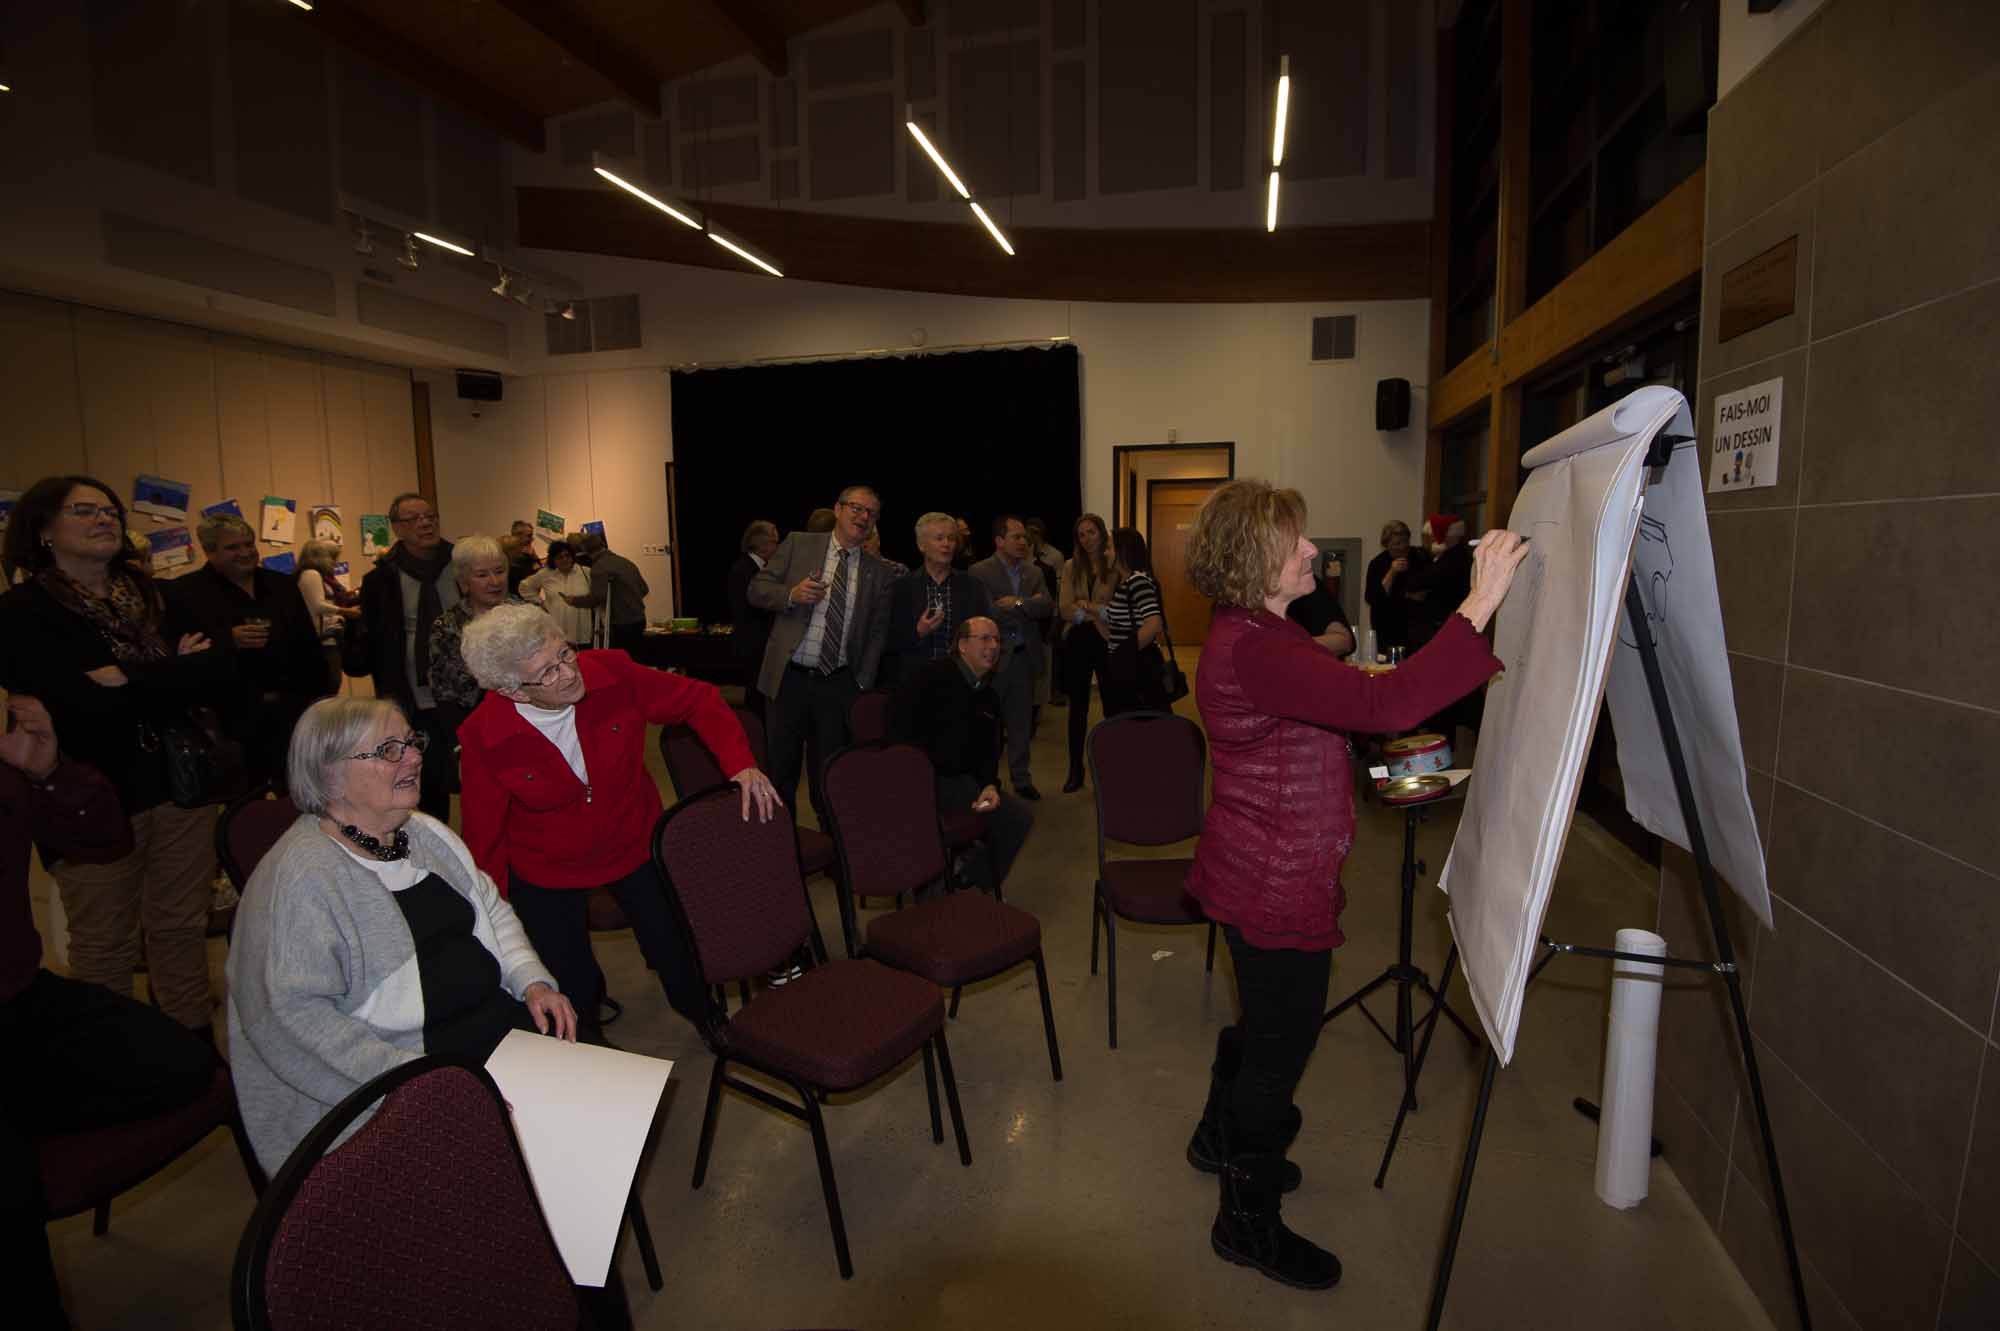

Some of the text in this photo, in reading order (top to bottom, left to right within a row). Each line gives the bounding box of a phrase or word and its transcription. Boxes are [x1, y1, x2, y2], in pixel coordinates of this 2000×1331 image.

[1720, 394, 1770, 423] FAIS-MOI
[1715, 426, 1772, 453] UN DESSIN
